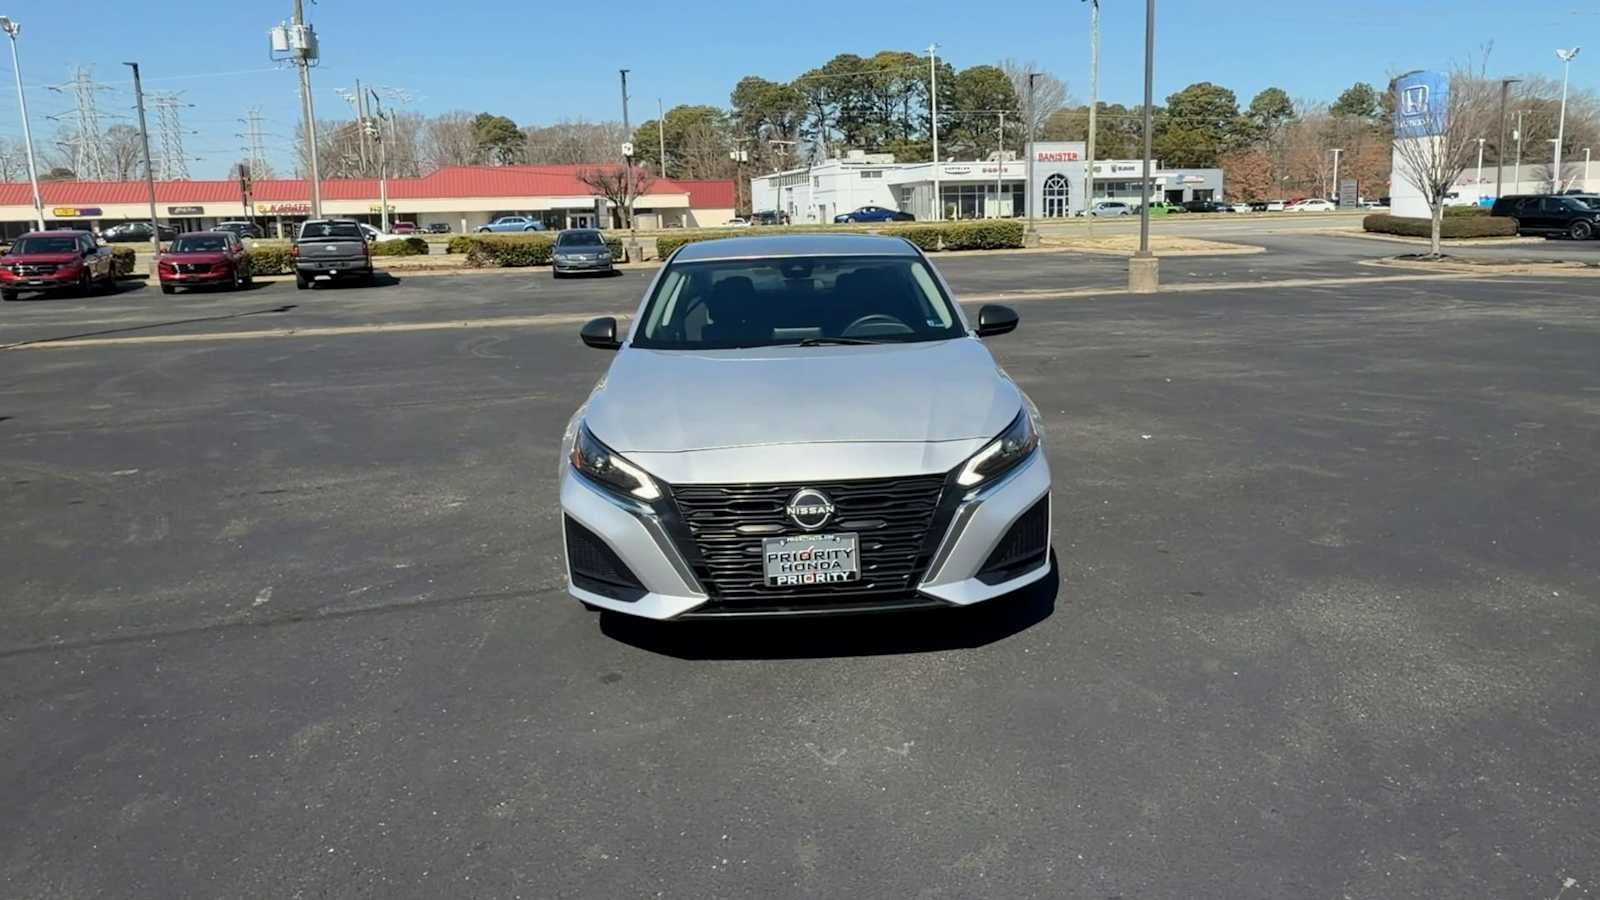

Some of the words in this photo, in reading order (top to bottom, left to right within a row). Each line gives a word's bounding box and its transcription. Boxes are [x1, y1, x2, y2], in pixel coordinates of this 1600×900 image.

[1038, 152, 1078, 162] BANISTER
[786, 505, 834, 515] NISSAN
[768, 549, 853, 563] PRIORITY
[781, 561, 842, 572] HONDA
[777, 572, 849, 585] PRIORITY
